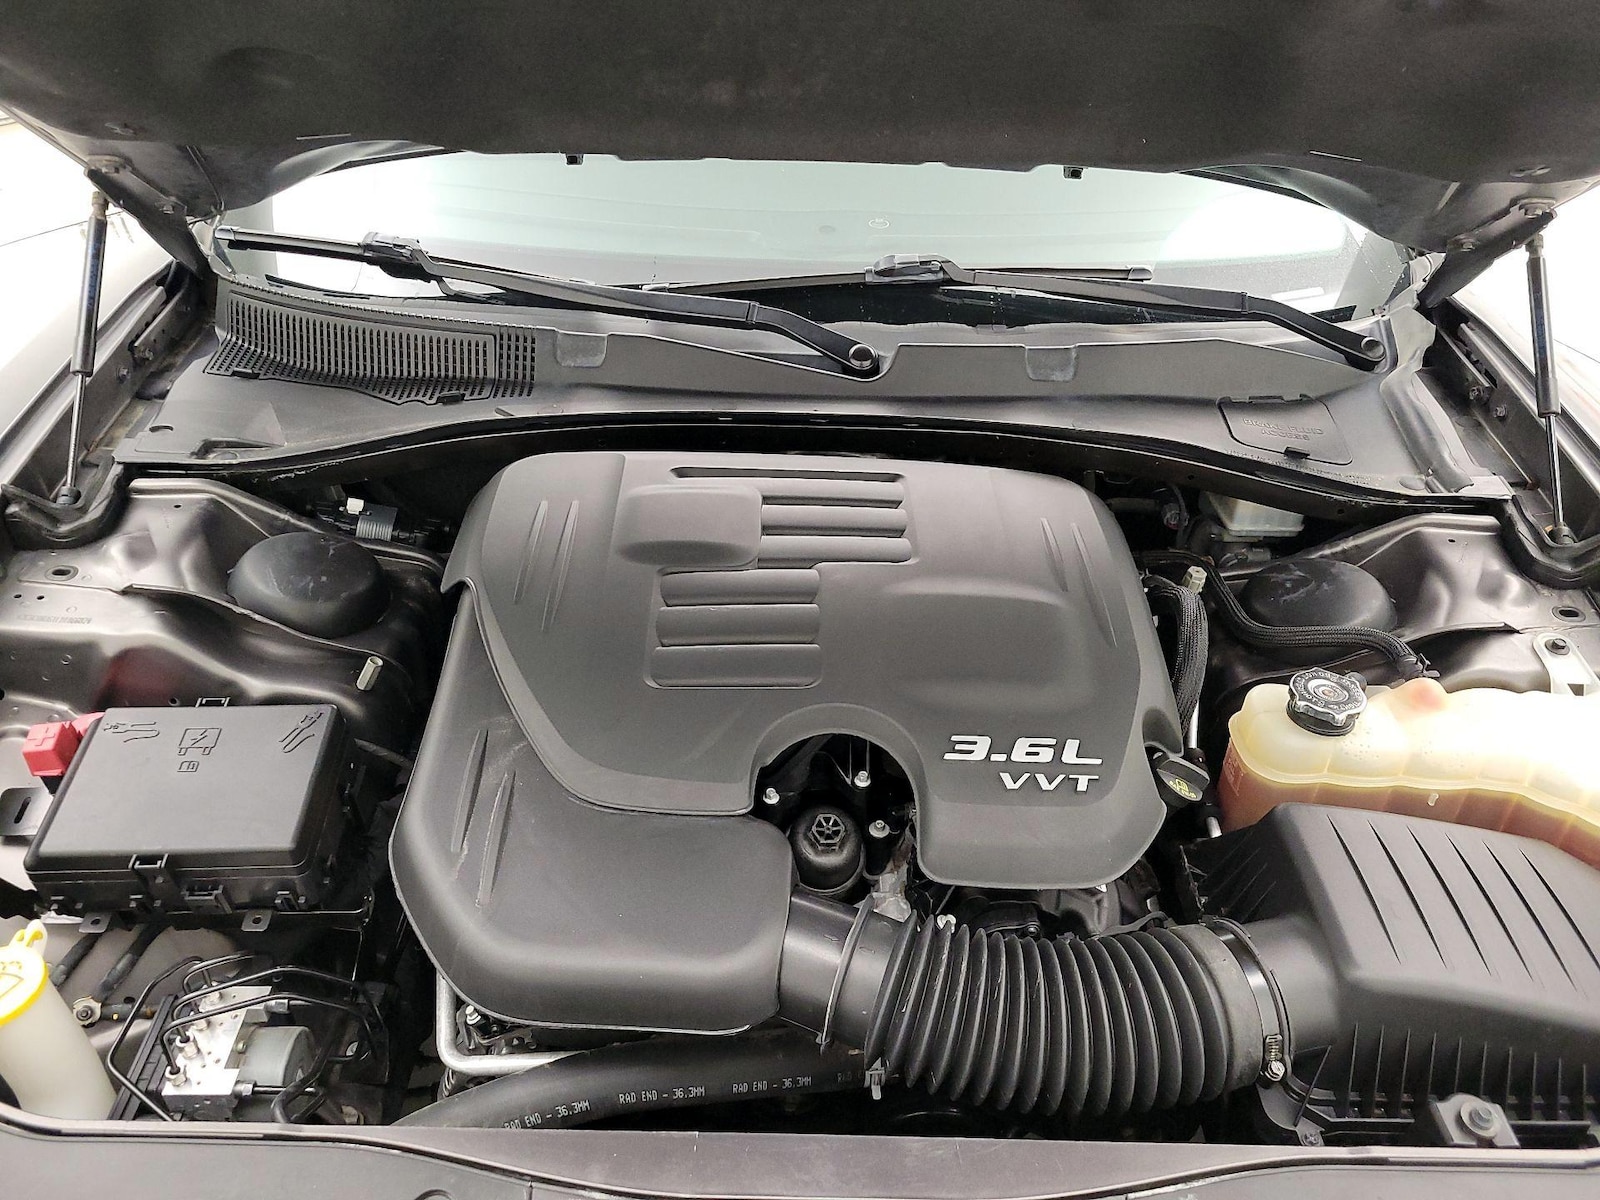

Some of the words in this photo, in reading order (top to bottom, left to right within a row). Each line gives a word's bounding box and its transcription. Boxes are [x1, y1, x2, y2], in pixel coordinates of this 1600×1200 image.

[943, 734, 1103, 765] 3.6L
[999, 772, 1100, 792] VVT
[618, 1092, 637, 1104] RAD
[641, 1090, 658, 1102] END
[672, 1086, 706, 1099] 36.3MM
[732, 1083, 748, 1094] RAD
[753, 1081, 768, 1092] END
[782, 1076, 812, 1089] 36.3MM
[524, 1112, 542, 1127] END
[555, 1099, 591, 1118] 36.3MM
